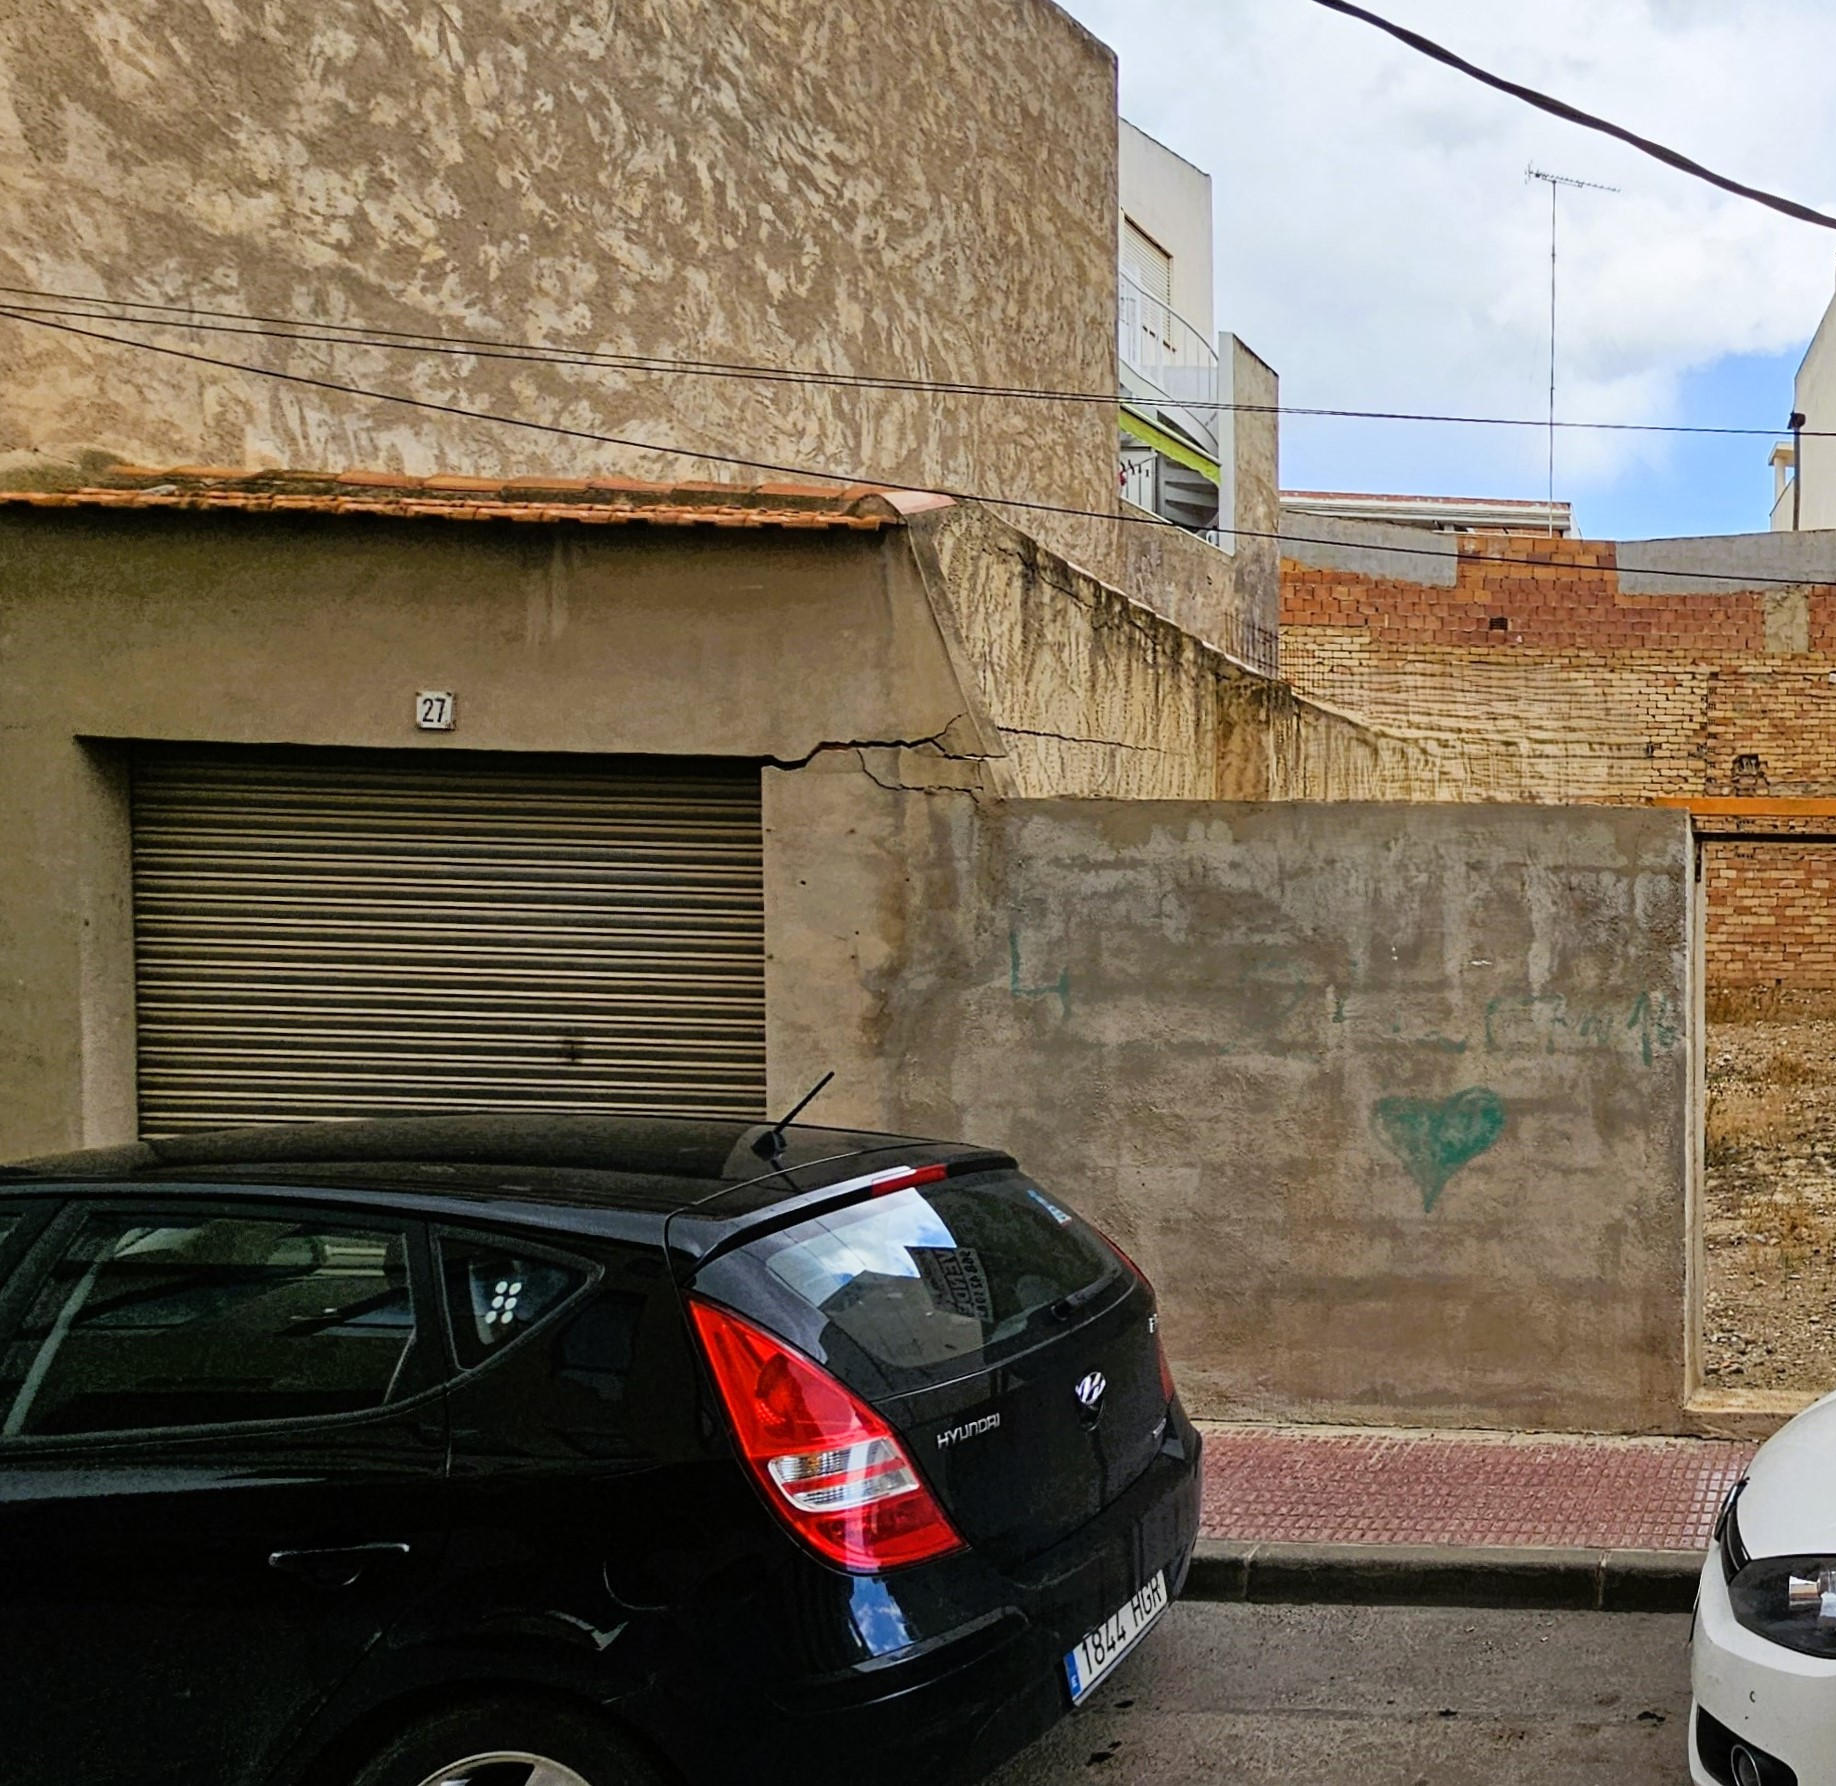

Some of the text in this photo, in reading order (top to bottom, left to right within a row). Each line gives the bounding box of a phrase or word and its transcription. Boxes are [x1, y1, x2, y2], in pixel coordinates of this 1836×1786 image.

[422, 698, 446, 723] 27
[936, 1412, 1001, 1449] HYUNDAI
[1083, 1575, 1162, 1675] 1844 HGR
